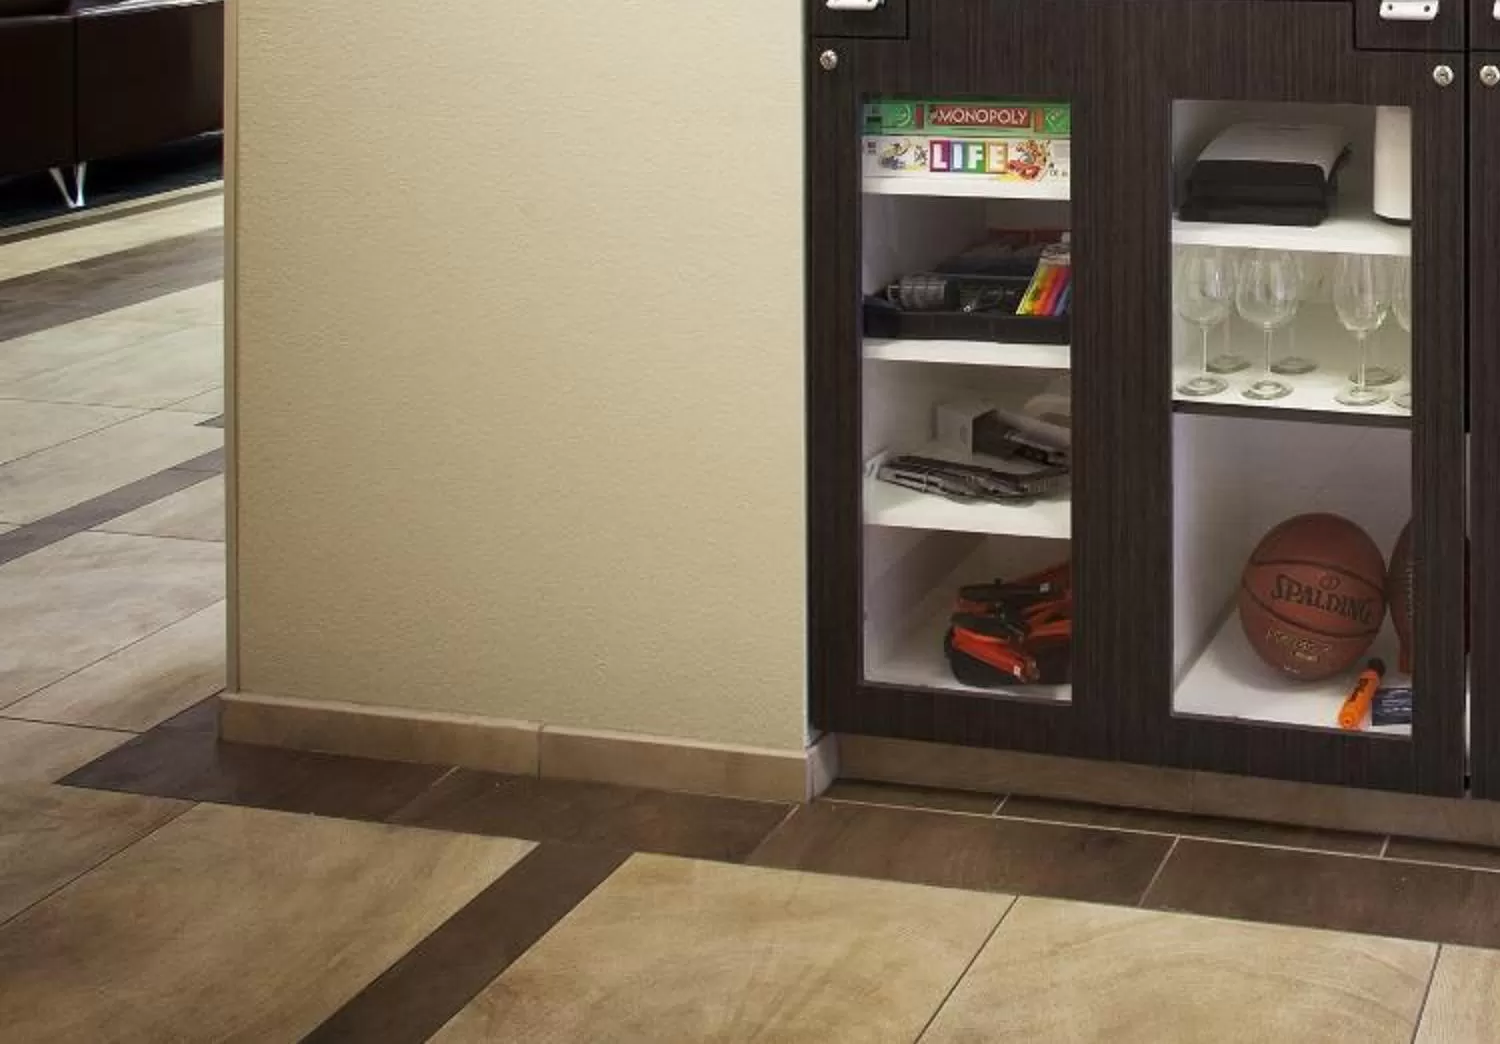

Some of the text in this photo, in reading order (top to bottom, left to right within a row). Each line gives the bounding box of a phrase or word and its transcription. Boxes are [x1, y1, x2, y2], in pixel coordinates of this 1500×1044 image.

[936, 107, 1028, 125] MONOPOLY
[932, 143, 1006, 170] LIFE
[1270, 573, 1374, 626] SPALDING
